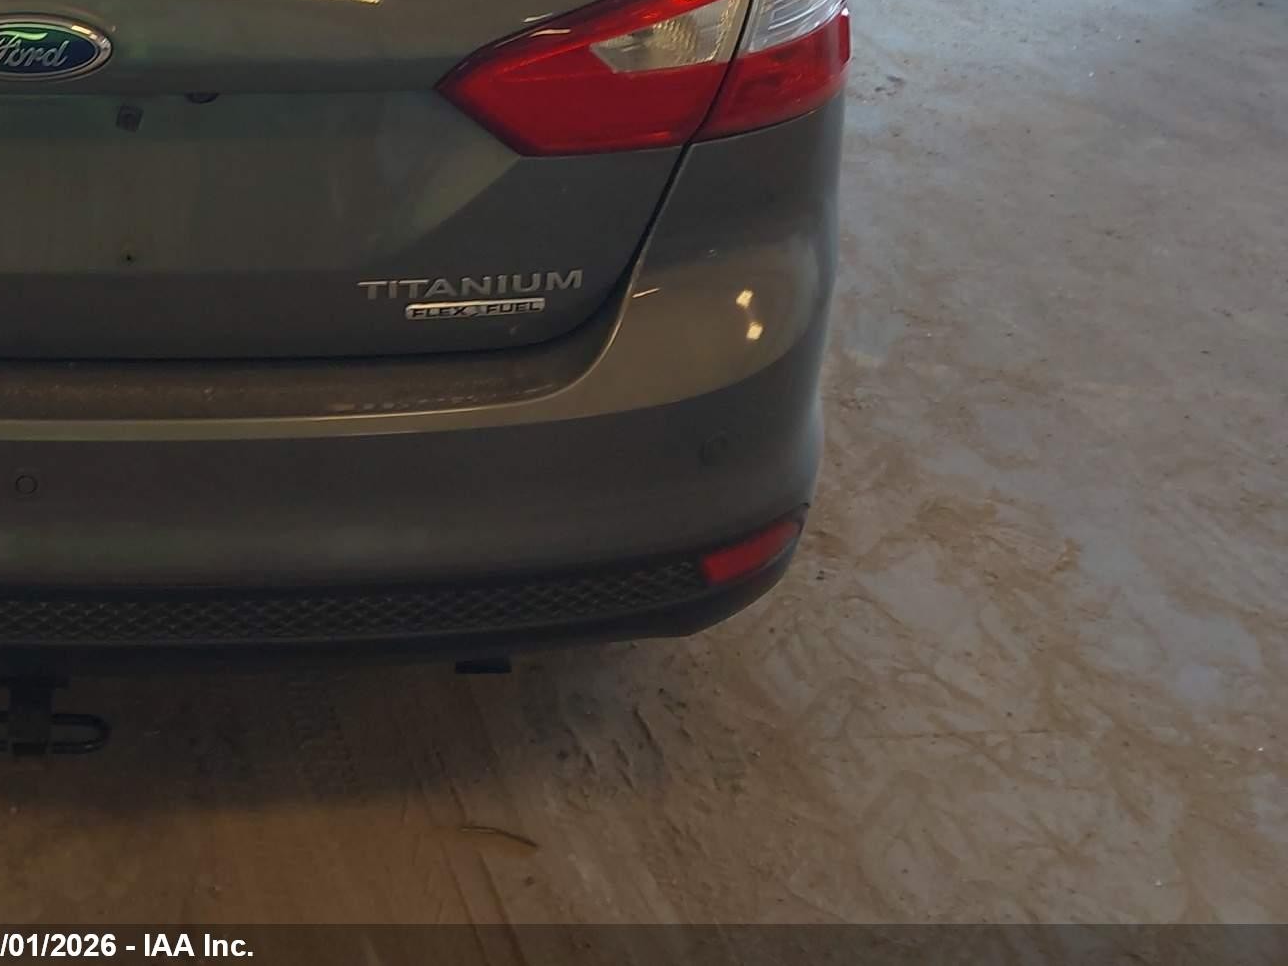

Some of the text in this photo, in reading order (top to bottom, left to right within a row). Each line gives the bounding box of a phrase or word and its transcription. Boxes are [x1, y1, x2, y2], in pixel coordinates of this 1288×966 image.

[357, 269, 584, 299] TITANIUM
[411, 300, 541, 319] FLEX FUEL
